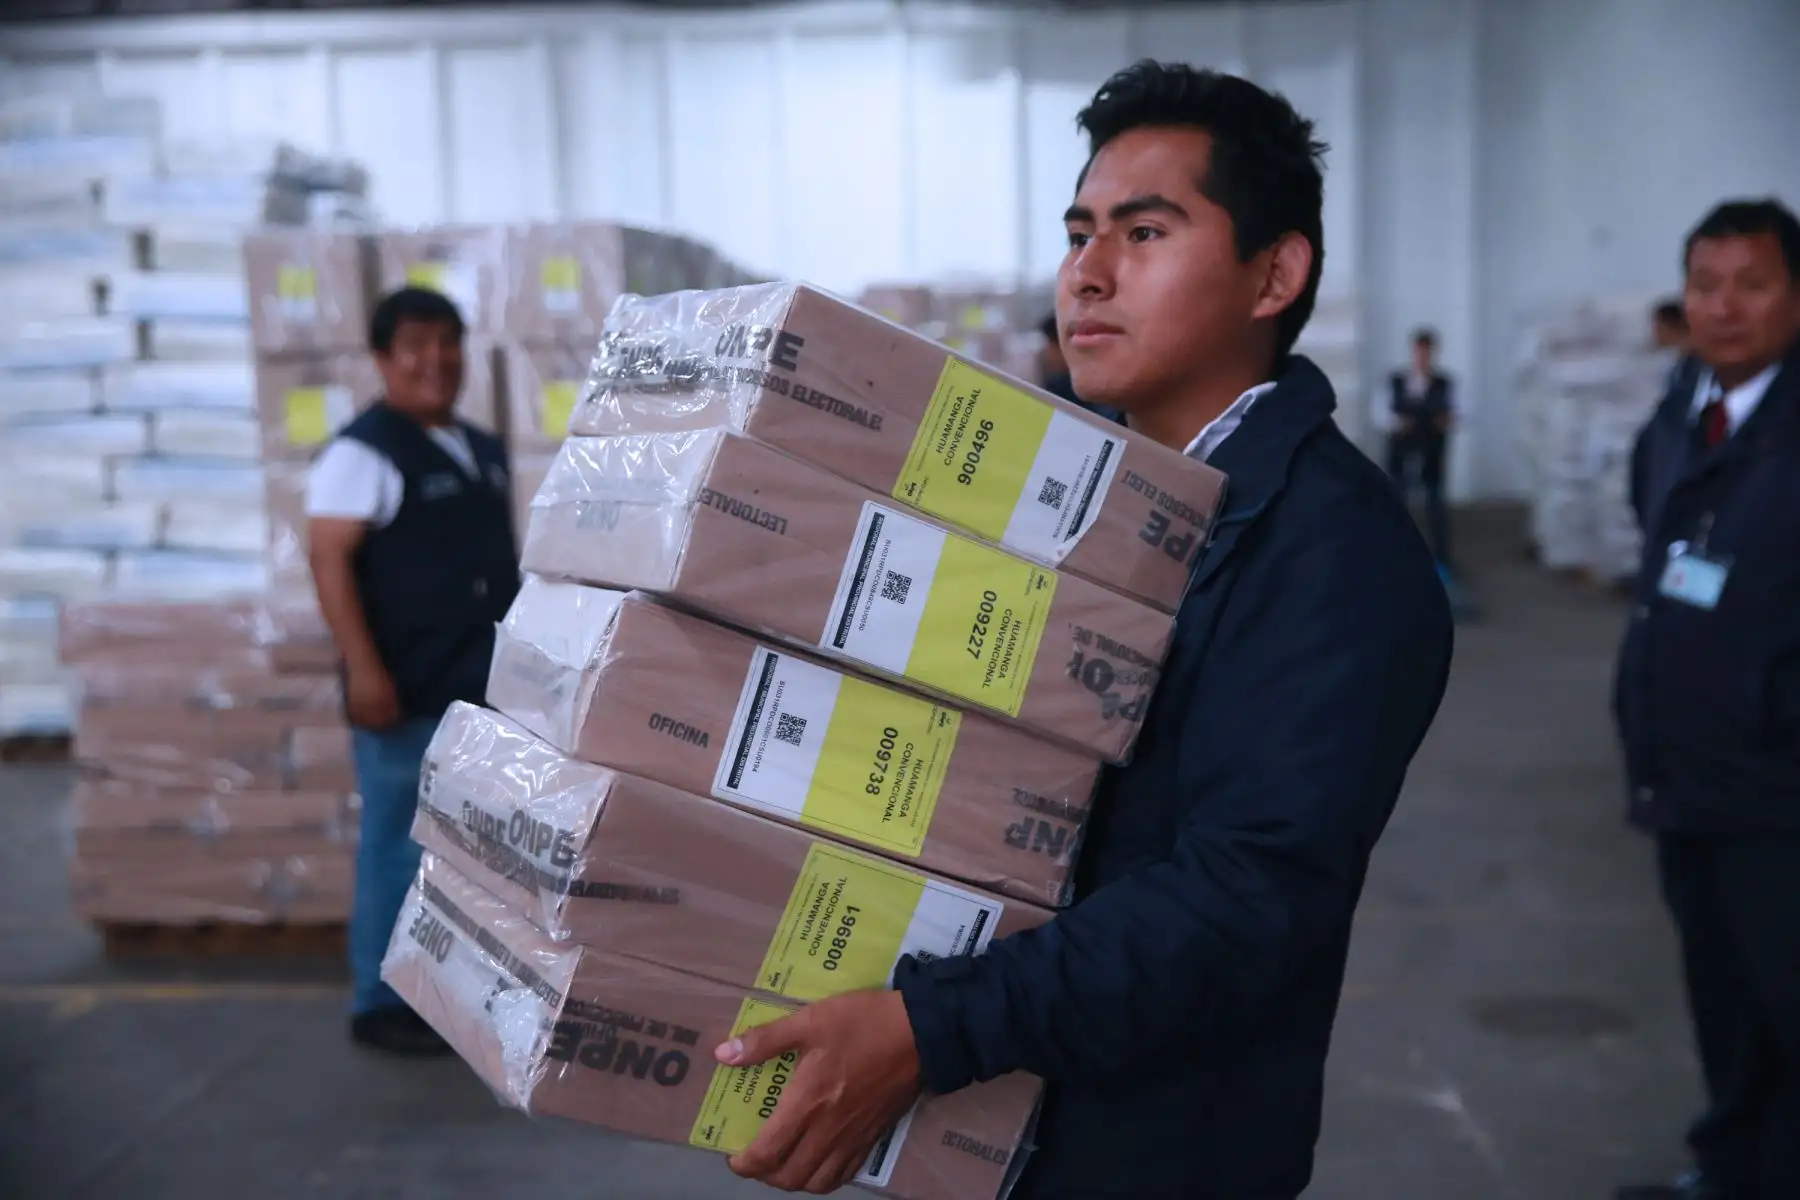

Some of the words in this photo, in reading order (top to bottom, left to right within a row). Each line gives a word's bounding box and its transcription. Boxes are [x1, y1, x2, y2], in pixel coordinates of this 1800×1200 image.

[934, 394, 965, 453] HUAMANGA
[943, 387, 981, 466] CONVENCIONAL
[956, 417, 995, 486] 900496
[964, 588, 998, 659] 009227
[981, 607, 1012, 689] CONVENCIONAL
[997, 619, 1021, 679] HUAMANGA
[648, 711, 710, 749] OFICINA
[864, 725, 899, 797] 009738
[881, 741, 914, 824] CONVENCIONAL
[898, 757, 923, 818] HUAMANGA
[799, 880, 830, 940] HUAMANGA
[808, 875, 847, 956] CONVENCIONAL
[821, 904, 860, 971] 008961
[546, 1021, 691, 1087] ONPE
[742, 1058, 766, 1103] CONVEN
[756, 1050, 796, 1119] 009075
